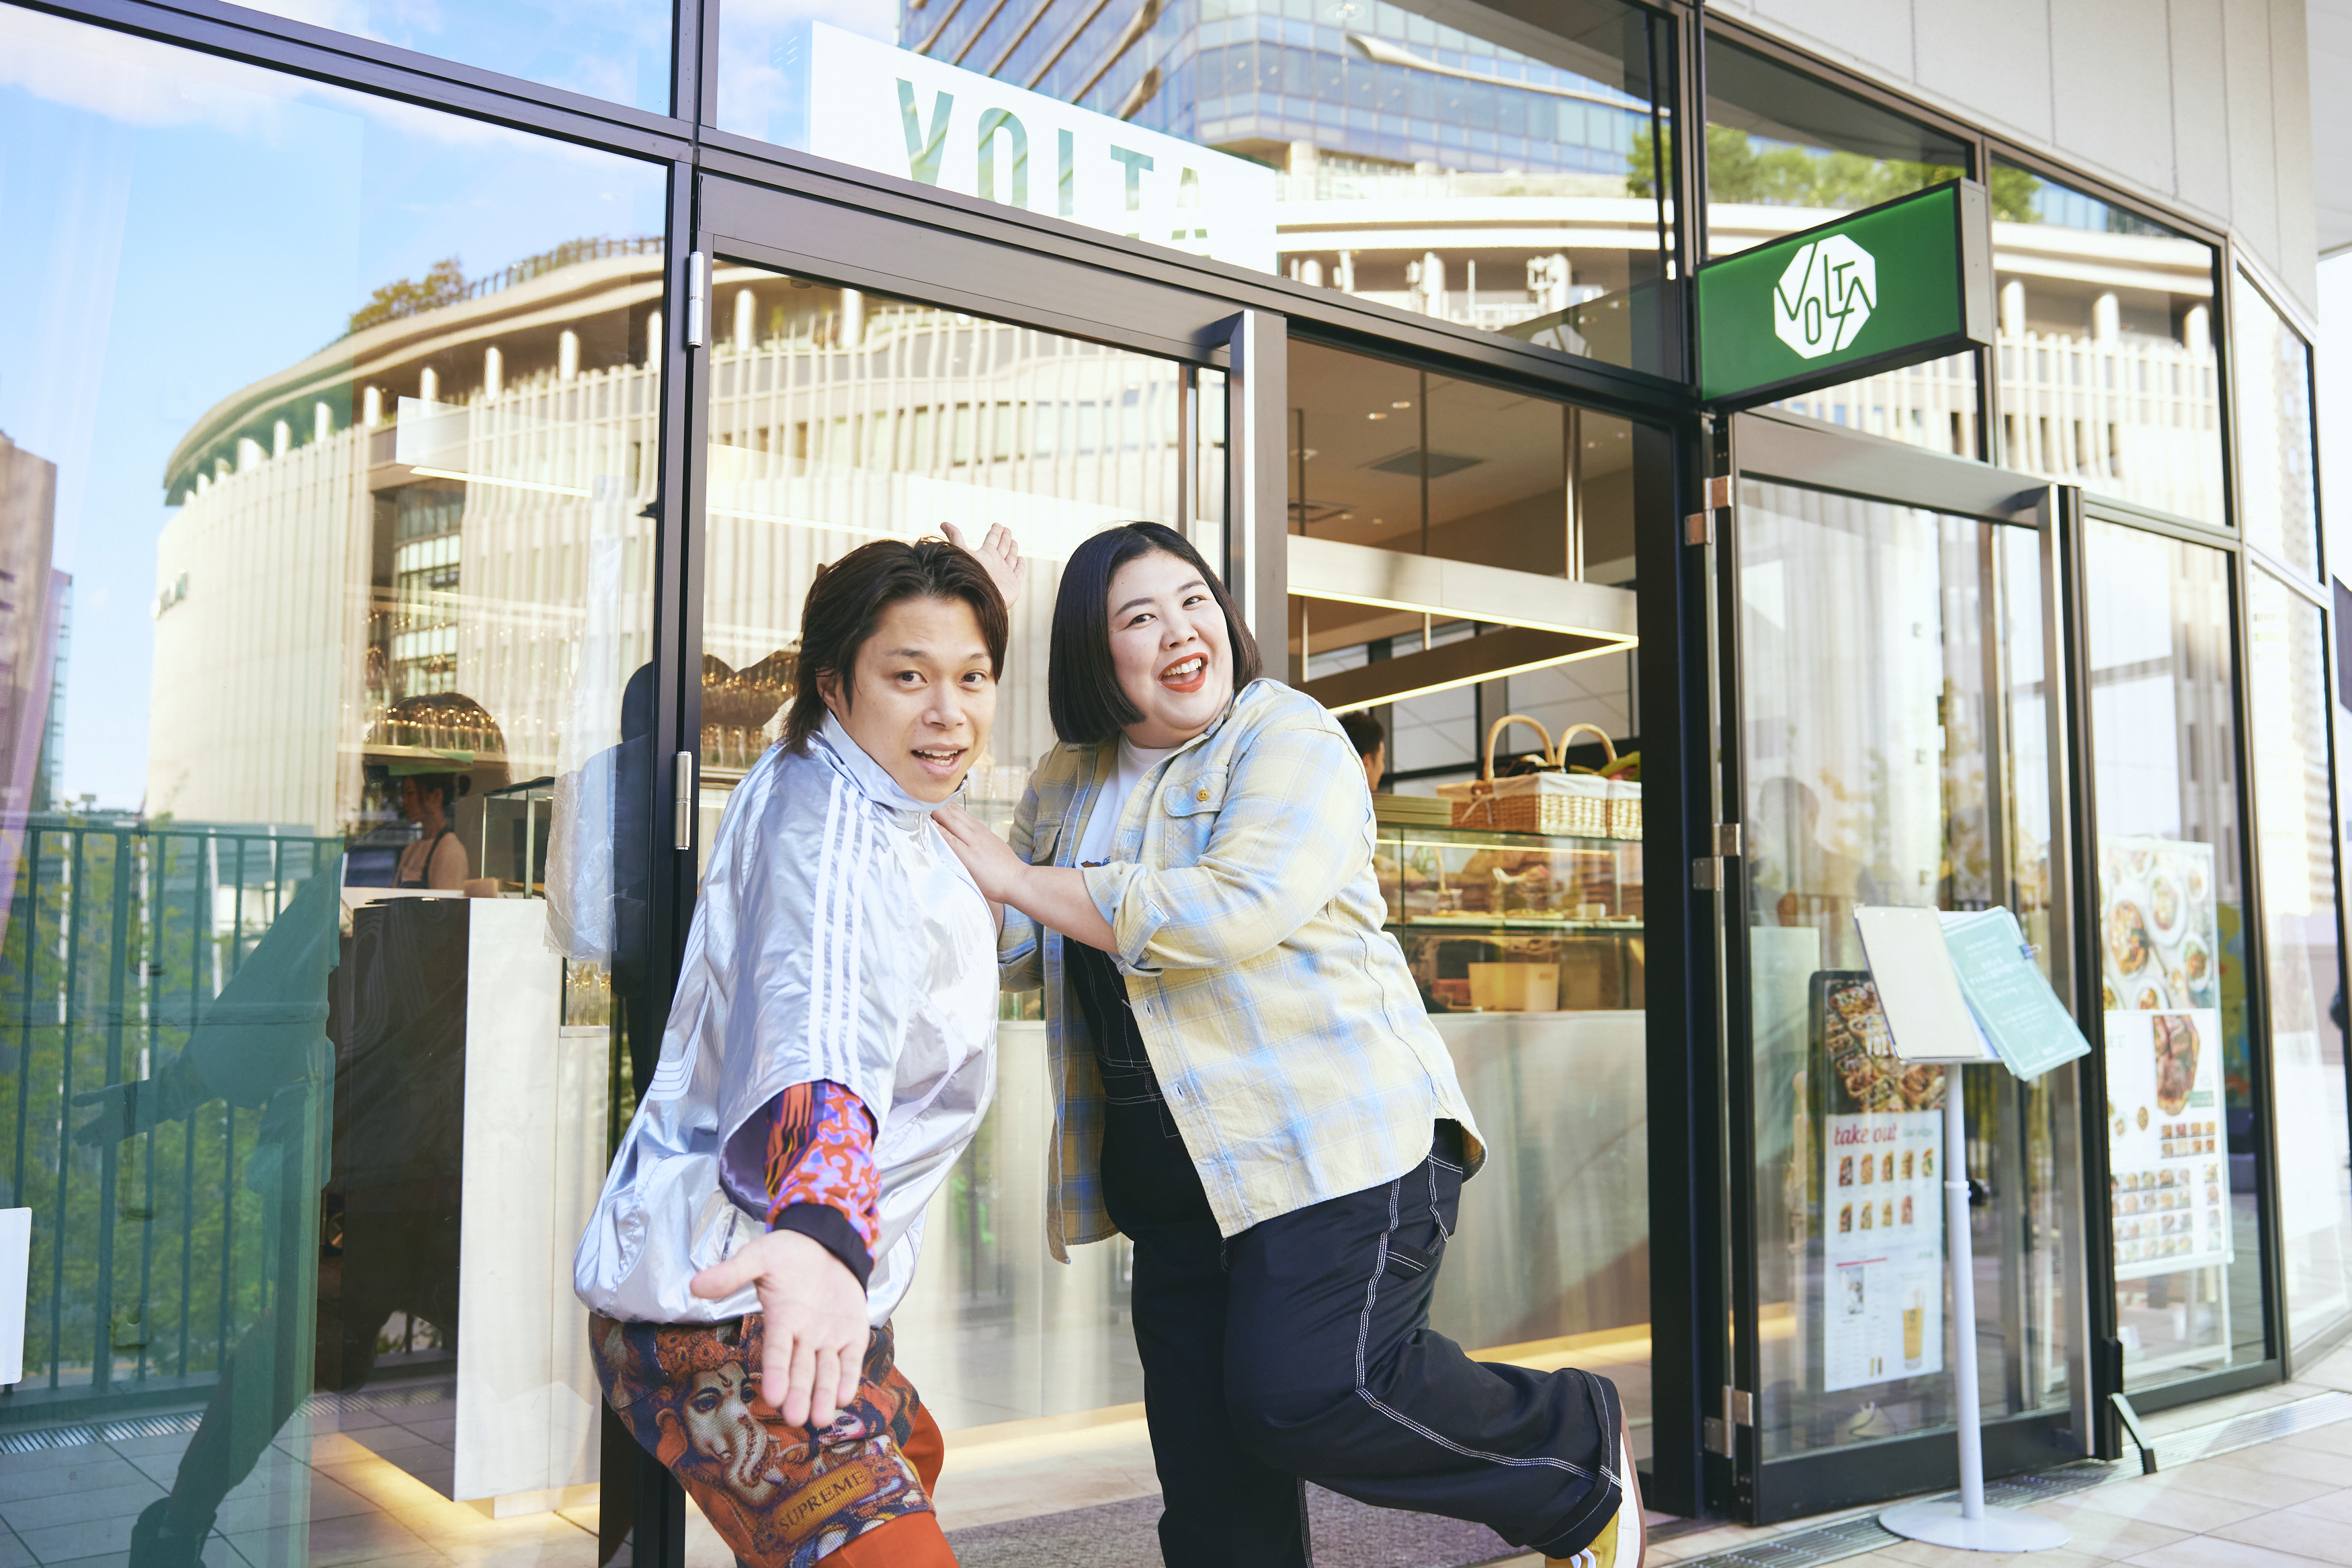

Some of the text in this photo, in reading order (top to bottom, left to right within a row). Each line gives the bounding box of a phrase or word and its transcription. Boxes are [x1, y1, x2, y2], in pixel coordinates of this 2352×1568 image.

[1774, 235, 1877, 356] VOLTA
[1834, 1123, 1869, 1145] take
[779, 1471, 867, 1530] SUPREME
